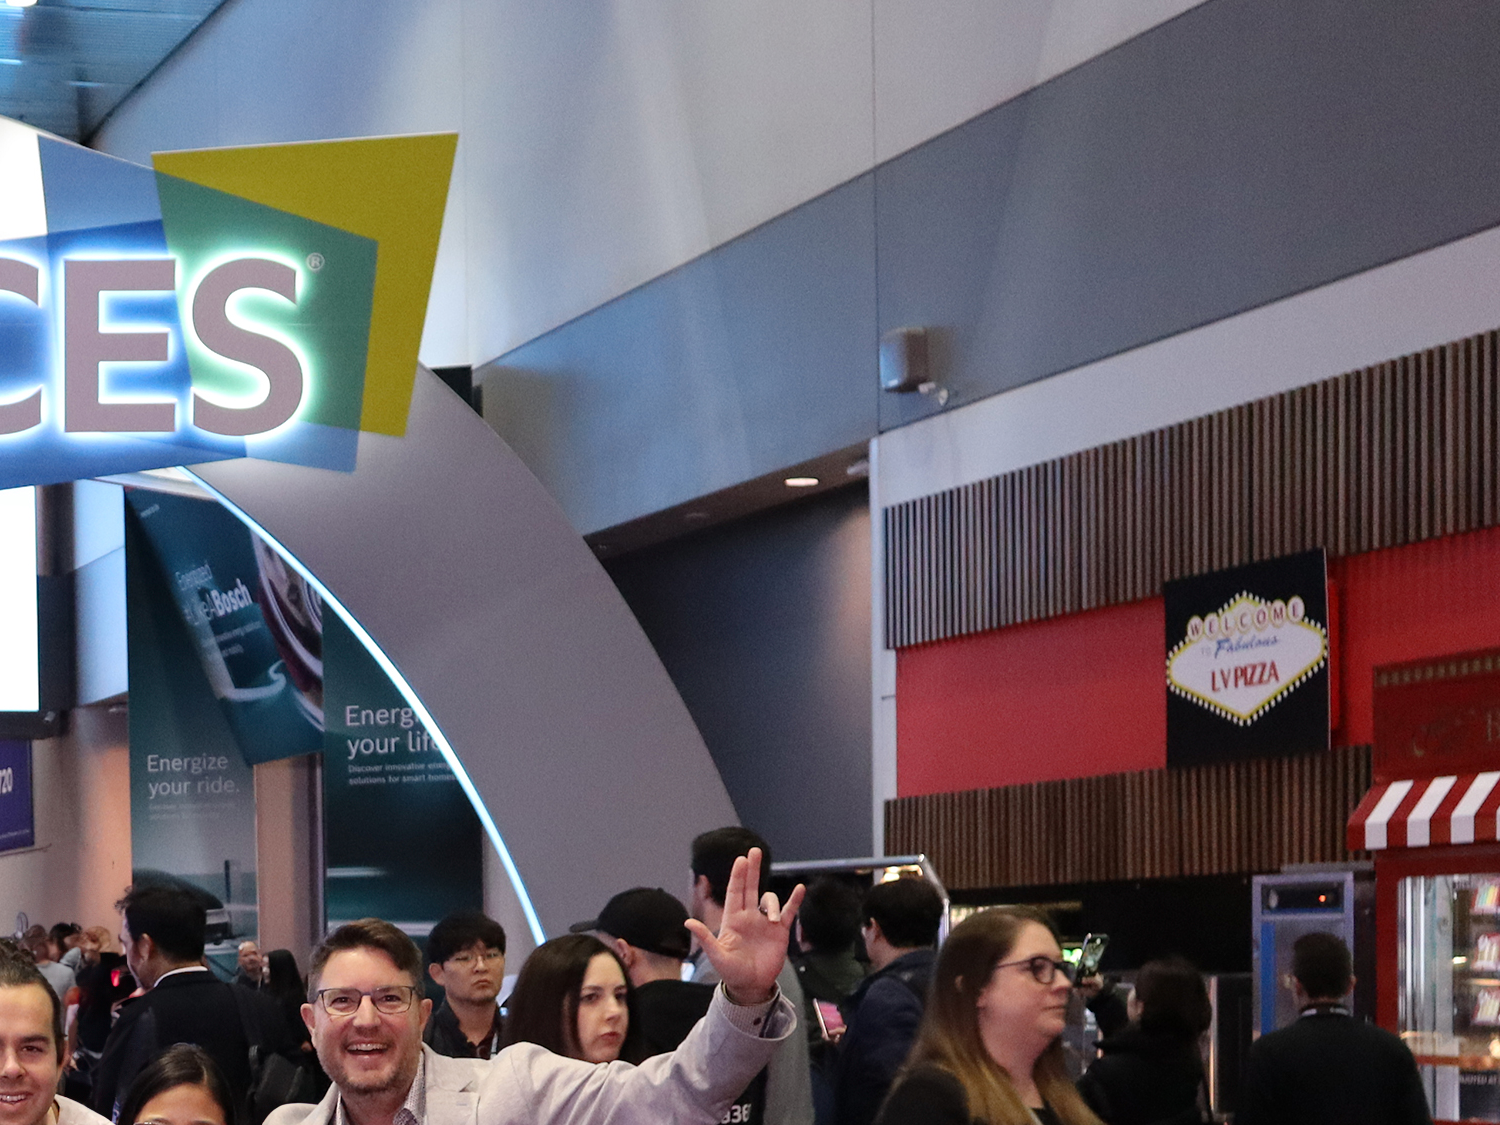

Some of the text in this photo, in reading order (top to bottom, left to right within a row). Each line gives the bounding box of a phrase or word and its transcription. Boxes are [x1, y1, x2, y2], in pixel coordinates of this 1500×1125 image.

[1189, 601, 1301, 637] WELCOME
[1233, 660, 1280, 689] PIZZA
[347, 733, 399, 760] your
[147, 752, 229, 775] Energize
[148, 775, 240, 800] your ride.
